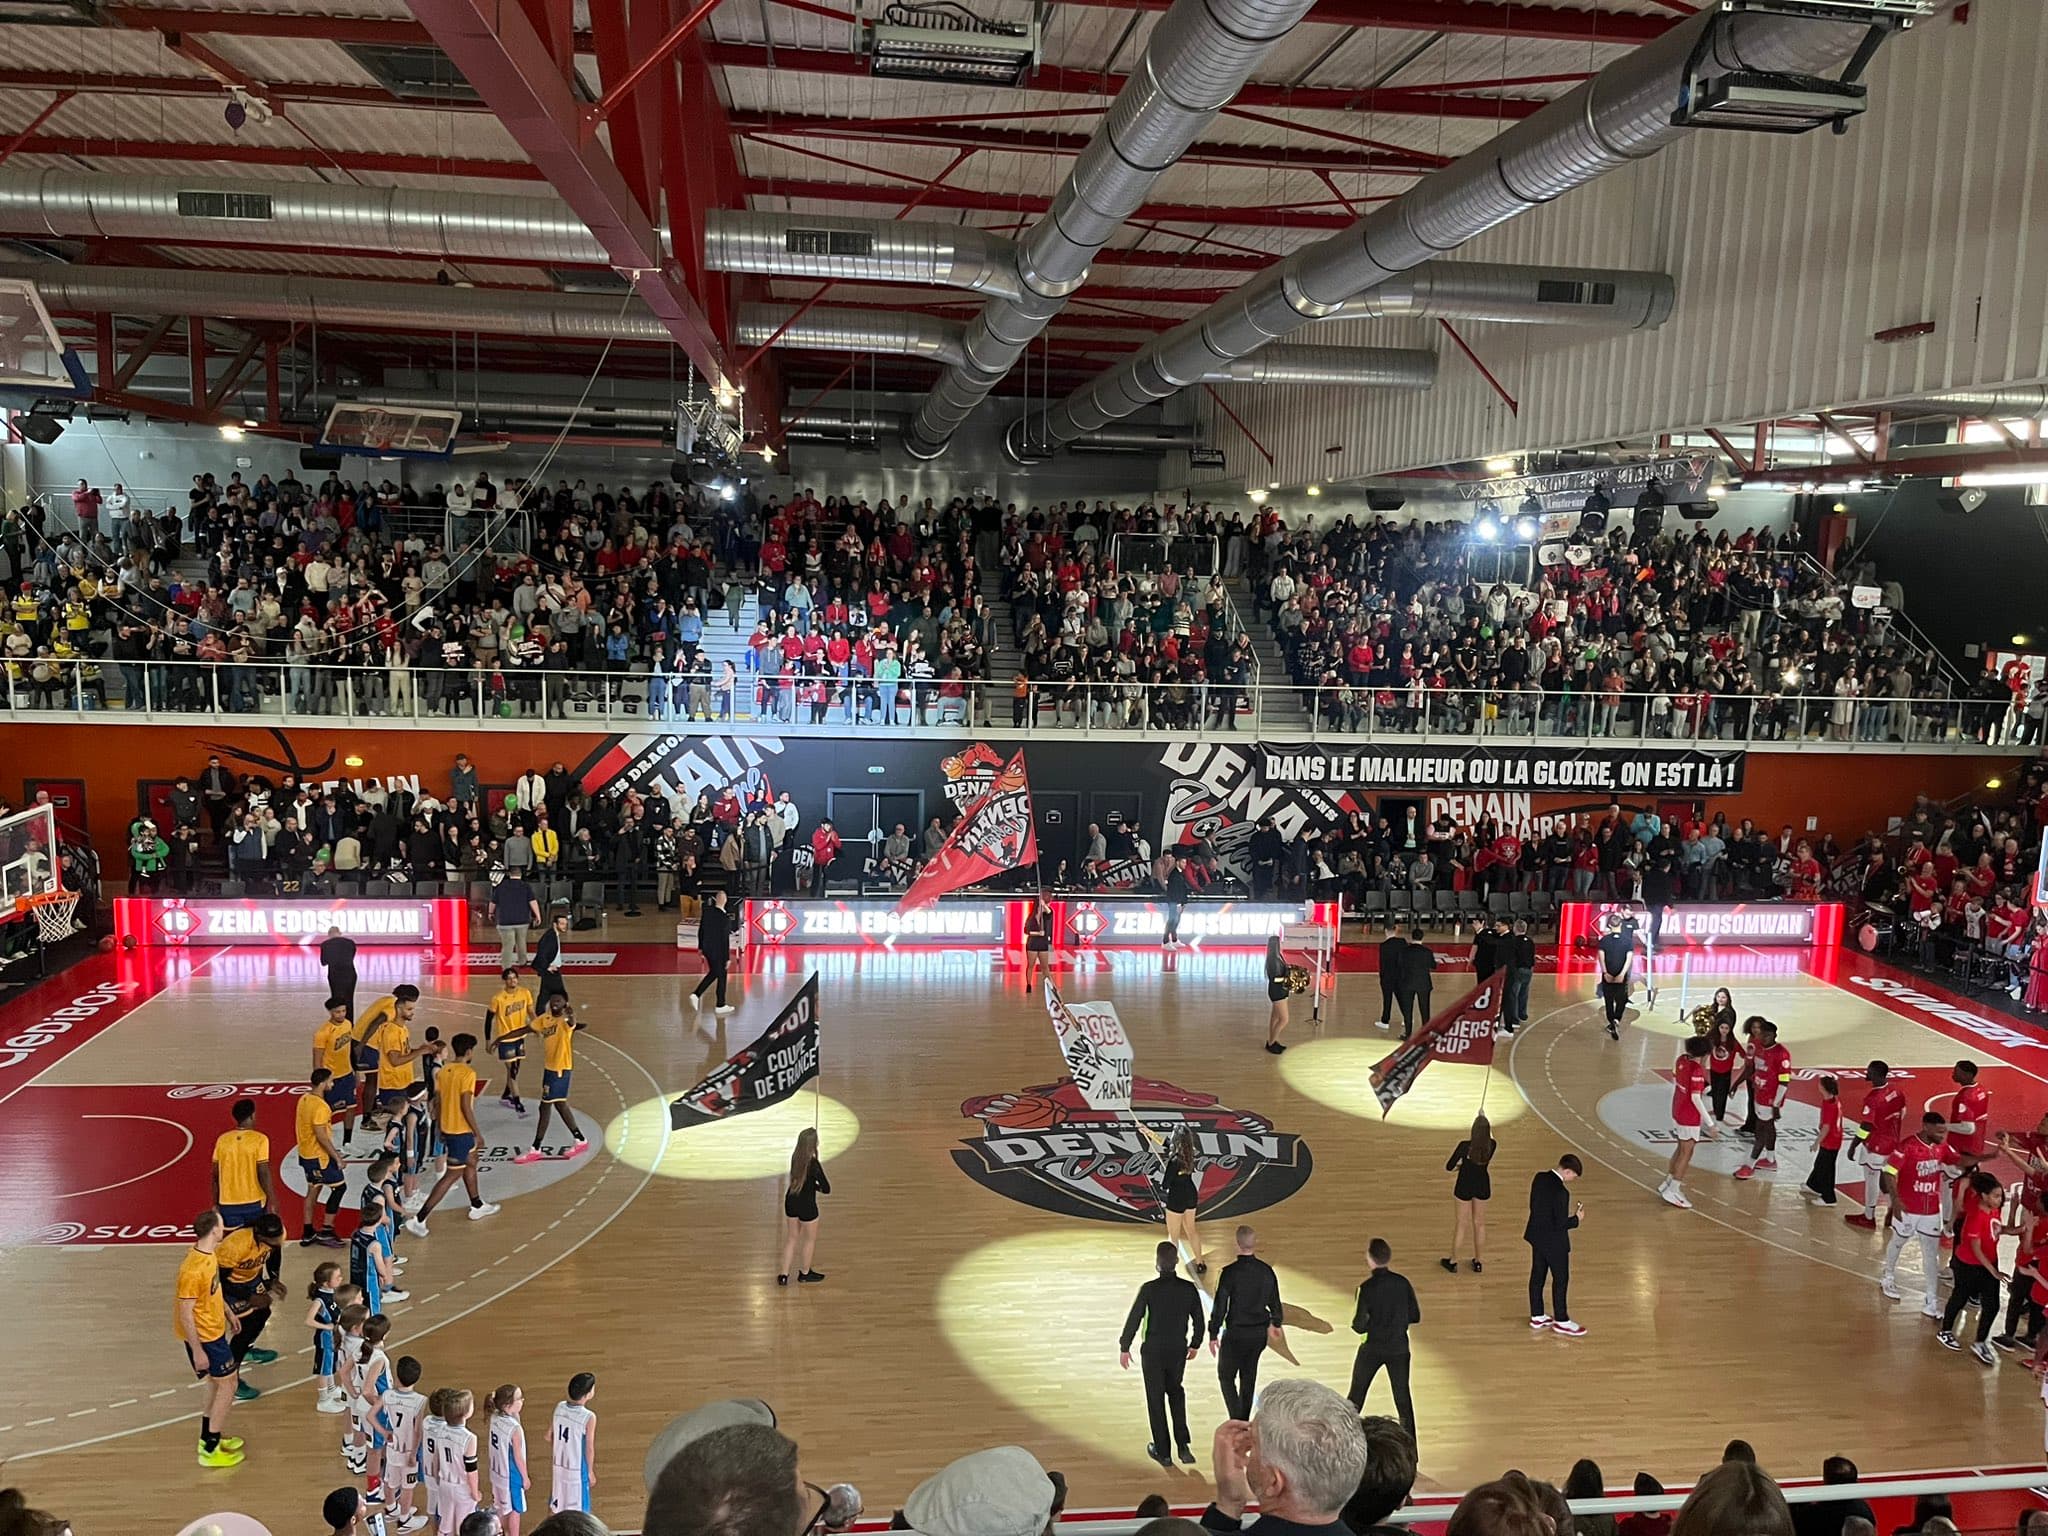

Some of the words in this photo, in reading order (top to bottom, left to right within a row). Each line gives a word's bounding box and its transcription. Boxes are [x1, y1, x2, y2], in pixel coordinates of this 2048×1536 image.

[1265, 755, 1326, 781] DANS
[1329, 756, 1355, 782] LE
[1359, 757, 1465, 784] MALHEUR
[1469, 758, 1499, 785] OU
[1503, 759, 1529, 785] LA
[1533, 760, 1616, 790] GLOIRE,
[1620, 761, 1650, 787] ON
[1654, 762, 1696, 787] EST
[1697, 757, 1723, 788] LÀ
[1726, 763, 1736, 788] !
[207, 910, 269, 934] ZENA
[273, 909, 419, 934] EDOSOMWAN
[803, 911, 858, 933] ZENA
[1685, 914, 1802, 936] EDOSOMWAN
[1445, 1019, 1491, 1038] DERS
[1435, 1037, 1471, 1054] CUP
[753, 1074, 775, 1100] DE
[776, 1049, 817, 1092] FRANCE
[239, 1085, 313, 1096] sue
[395, 1412, 404, 1428] 7
[558, 1424, 570, 1444] 14
[427, 1438, 436, 1454] 9
